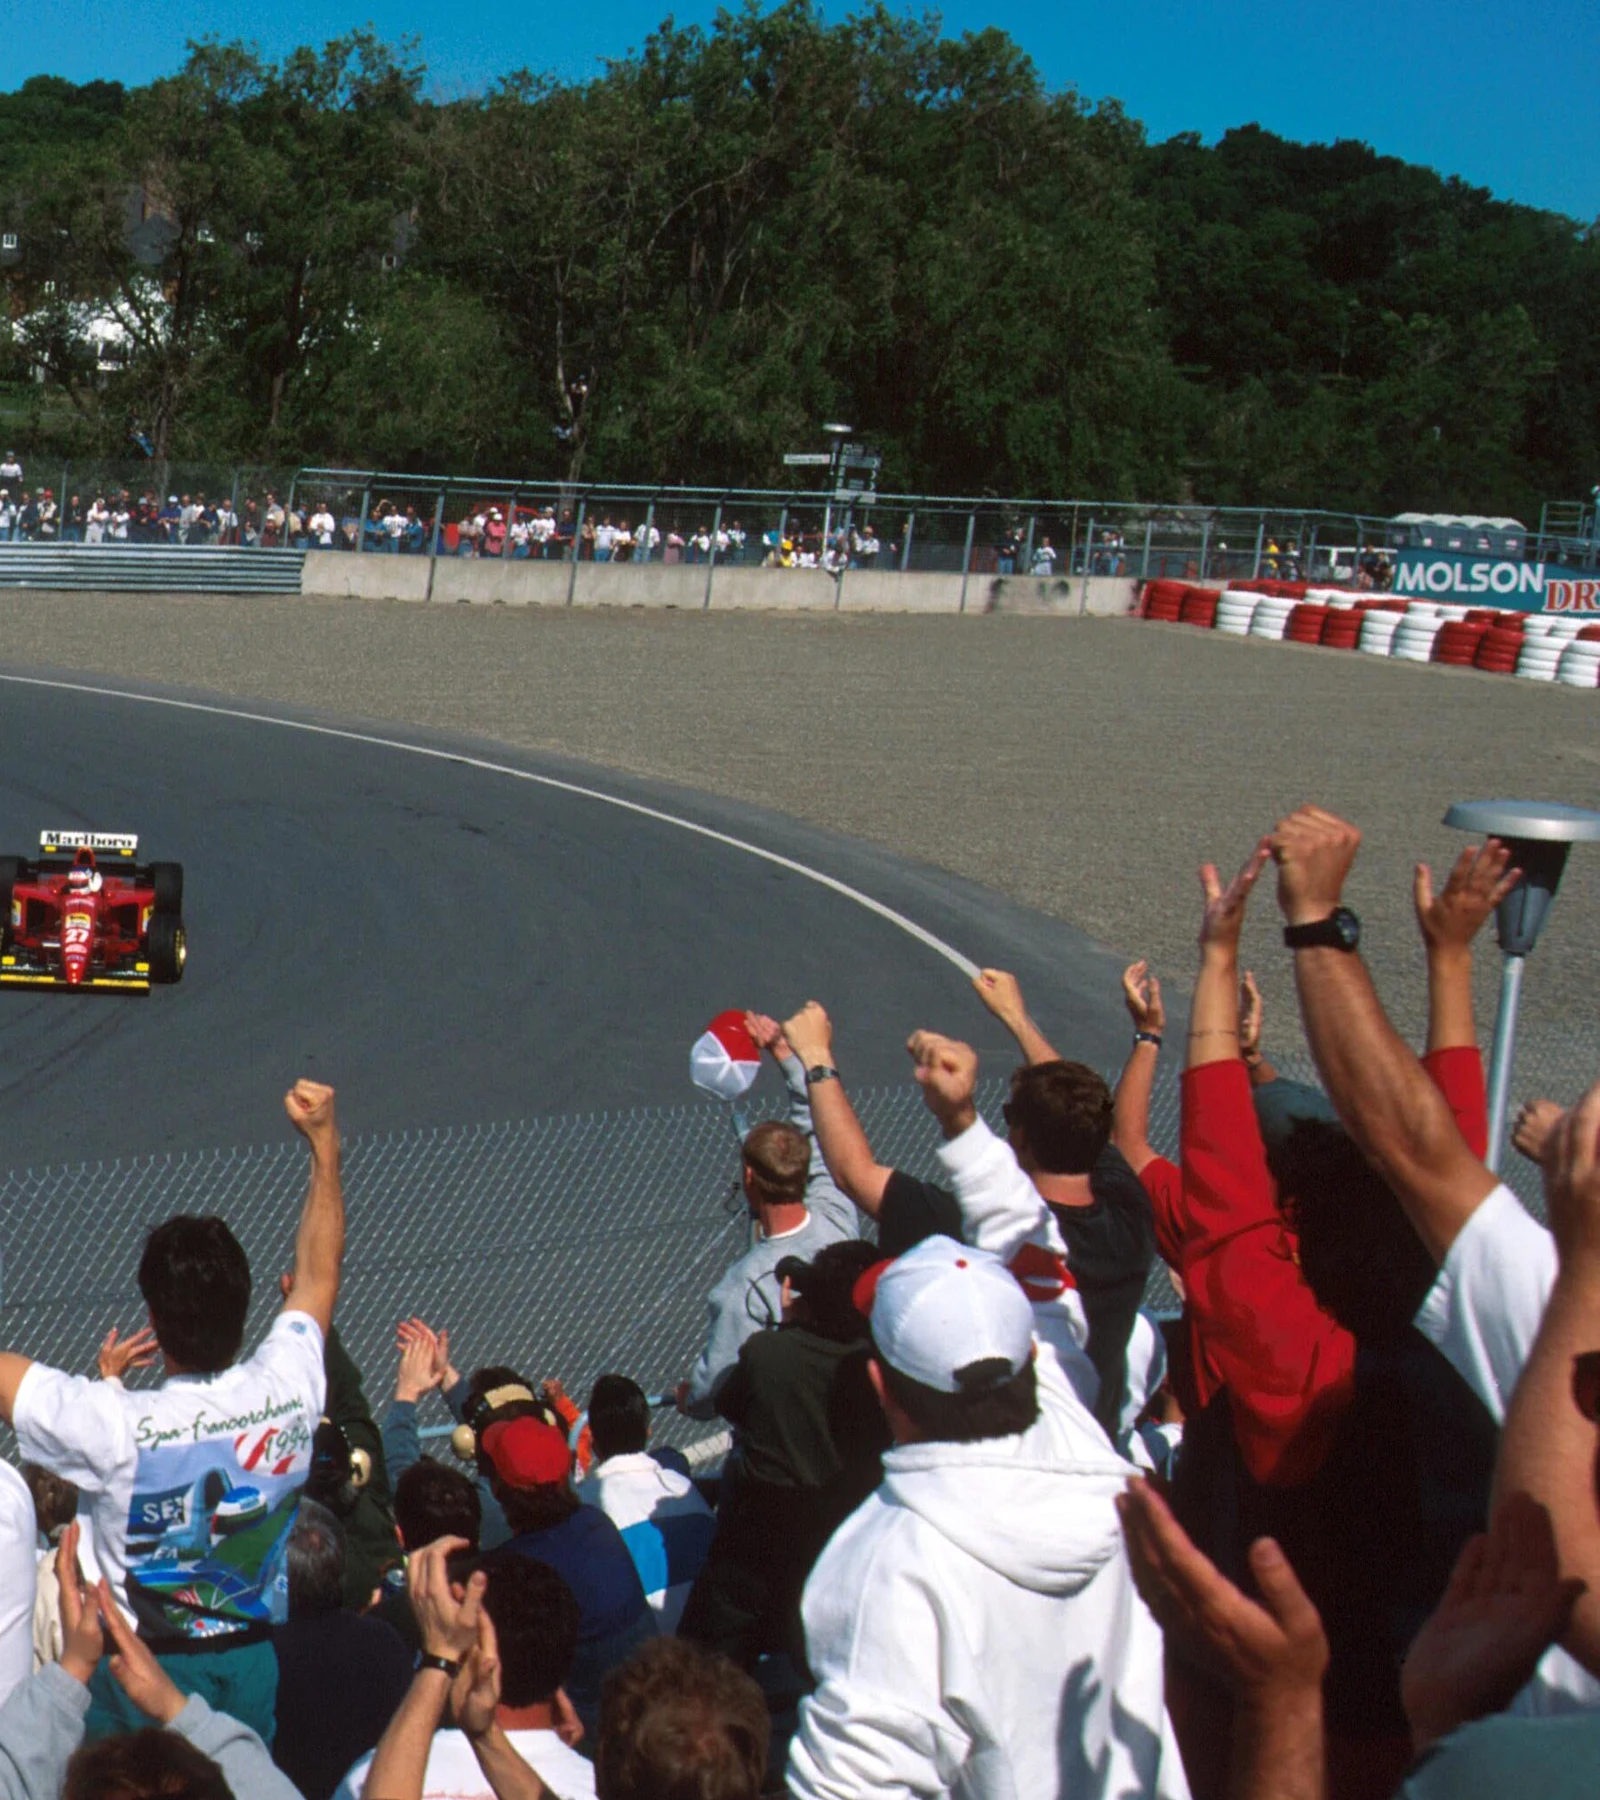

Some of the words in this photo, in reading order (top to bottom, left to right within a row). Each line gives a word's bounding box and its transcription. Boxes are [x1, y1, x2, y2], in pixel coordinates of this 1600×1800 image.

[1396, 561, 1545, 594] MOLSON
[46, 832, 133, 847] Marlboro
[65, 928, 89, 944] 27
[264, 1425, 311, 1461] 1994
